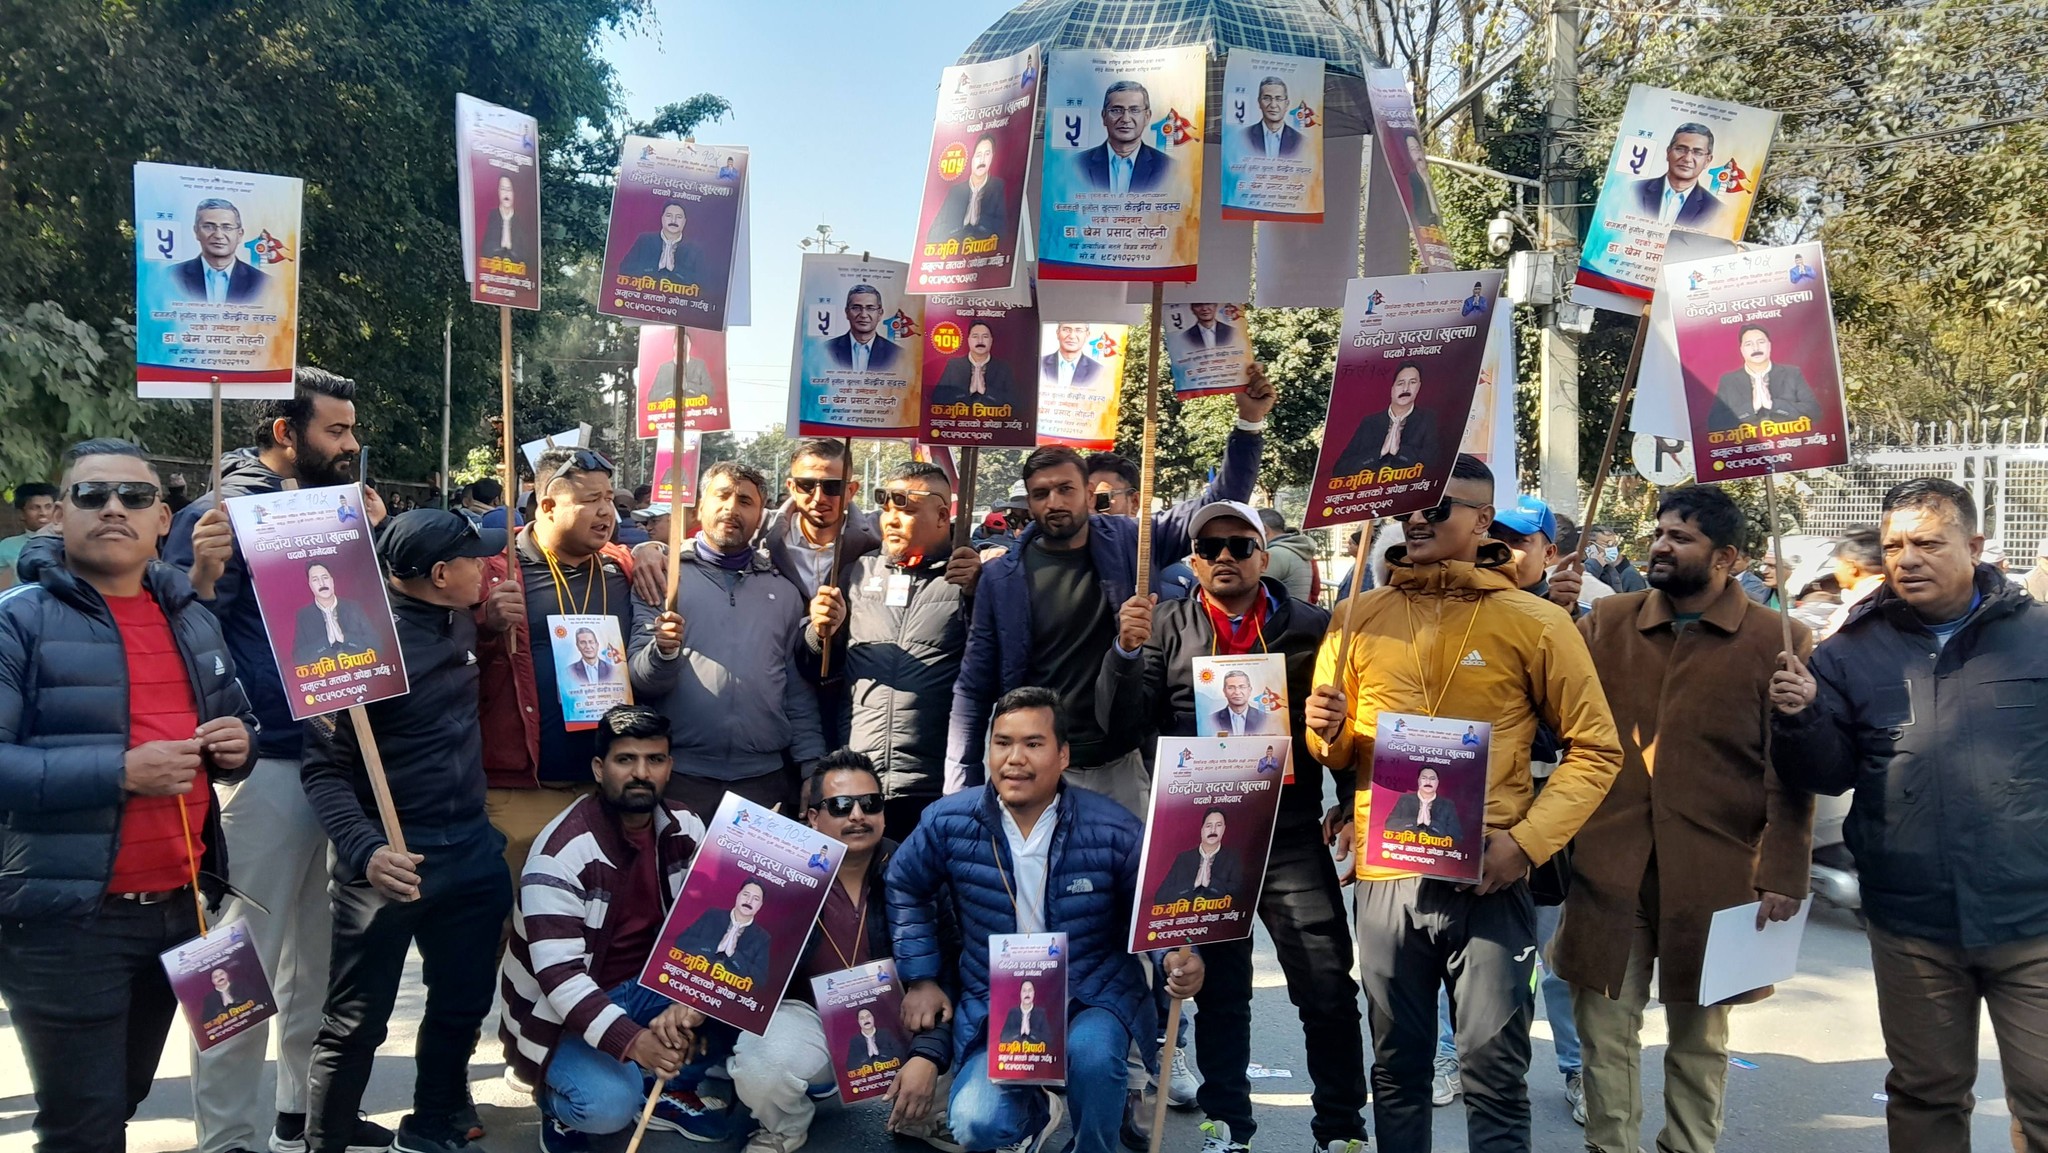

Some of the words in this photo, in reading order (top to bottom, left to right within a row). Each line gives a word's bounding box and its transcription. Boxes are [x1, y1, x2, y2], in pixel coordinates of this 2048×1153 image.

[979, 103, 1002, 119] सदस्य
[967, 121, 983, 133] पदको
[1065, 114, 1081, 146] ५
[940, 157, 964, 174] १०५
[1629, 145, 1648, 174] ५
[628, 170, 661, 185] केन्द्रीय
[664, 178, 695, 190] सदस्य
[652, 189, 671, 197] पदको
[672, 191, 702, 203] उम्मेदवार
[1083, 225, 1102, 237] खेम
[1106, 228, 1132, 237] प्रसाद
[156, 228, 174, 259] ५
[962, 234, 998, 255] त्रिपाठी
[1625, 245, 1642, 258] खेम
[1645, 251, 1663, 263] प्रसा
[660, 279, 700, 297] त्रिपाठी
[643, 293, 666, 303] मतको
[956, 309, 974, 317] पदको
[1686, 301, 1728, 318] केन्द्रीय
[1731, 297, 1767, 312] सदस्य
[818, 311, 830, 335] ५
[1720, 312, 1744, 325] पदको
[1746, 309, 1782, 322] उम्मेदवार
[934, 335, 960, 349] १०५
[1353, 329, 1395, 348] केन्द्रीय
[1398, 329, 1433, 345] सदस्य
[1383, 346, 1405, 359] पदको
[1407, 344, 1443, 358] उम्मेदवार
[973, 401, 1012, 417] त्रिपाठी
[1761, 416, 1812, 437] त्रिपाठी
[1745, 440, 1775, 453] मतको
[1377, 463, 1424, 483] त्रिपाठी
[1357, 486, 1383, 498] मतको
[255, 535, 292, 552] केन्द्रीय
[294, 534, 324, 547] सदस्य
[287, 550, 307, 560] पदको
[308, 547, 338, 558] उम्मेदवार
[337, 648, 377, 670] त्रिपाठी
[329, 672, 352, 686] मतको
[1206, 781, 1235, 793] सदस्य
[1193, 795, 1212, 804] पदको
[717, 834, 751, 858] केन्द्रीय
[752, 851, 782, 872] सदस्य
[737, 859, 756, 873] पदको
[756, 868, 788, 888] उम्मेदवार
[1193, 894, 1232, 912] त्रिपाठी
[690, 973, 716, 991] मतको
[710, 962, 753, 993] त्रिपाठी
